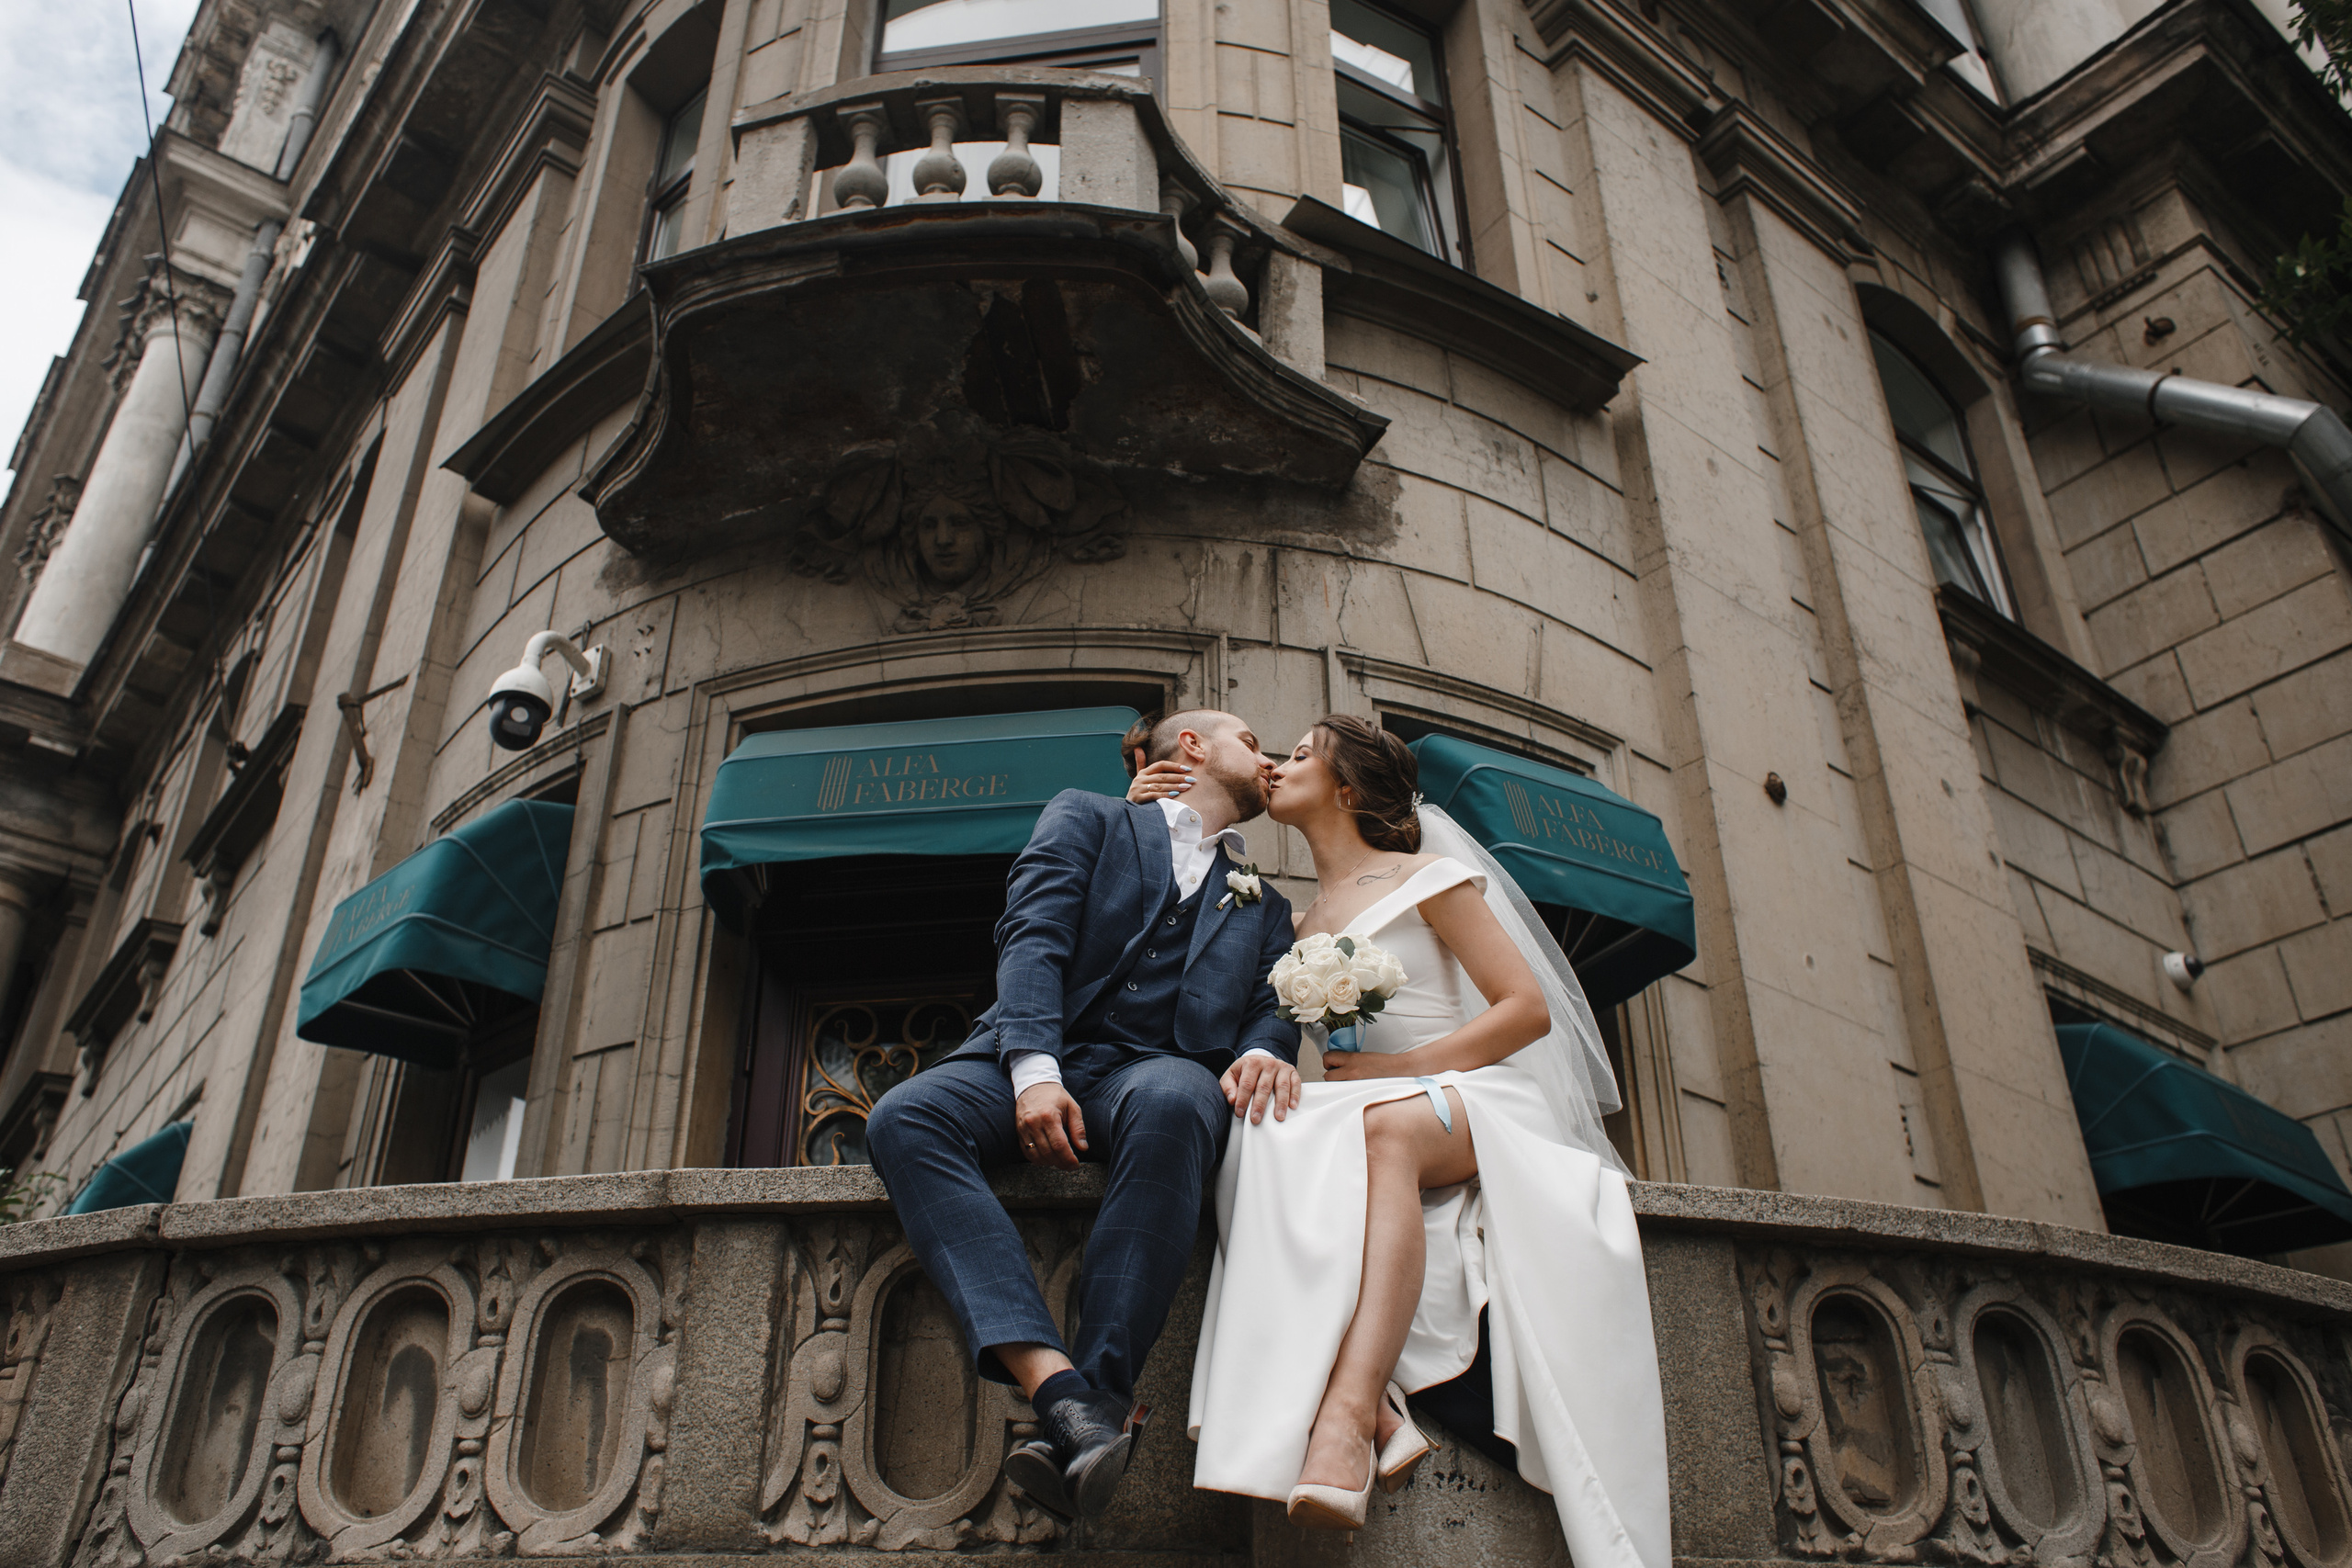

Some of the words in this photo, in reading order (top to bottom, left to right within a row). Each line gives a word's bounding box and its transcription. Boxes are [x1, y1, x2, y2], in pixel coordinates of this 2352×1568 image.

[856, 754, 940, 778] ALFA
[853, 773, 1009, 804] FABERGE
[1538, 795, 1605, 830] ALFA
[1542, 818, 1668, 874] FABERGE
